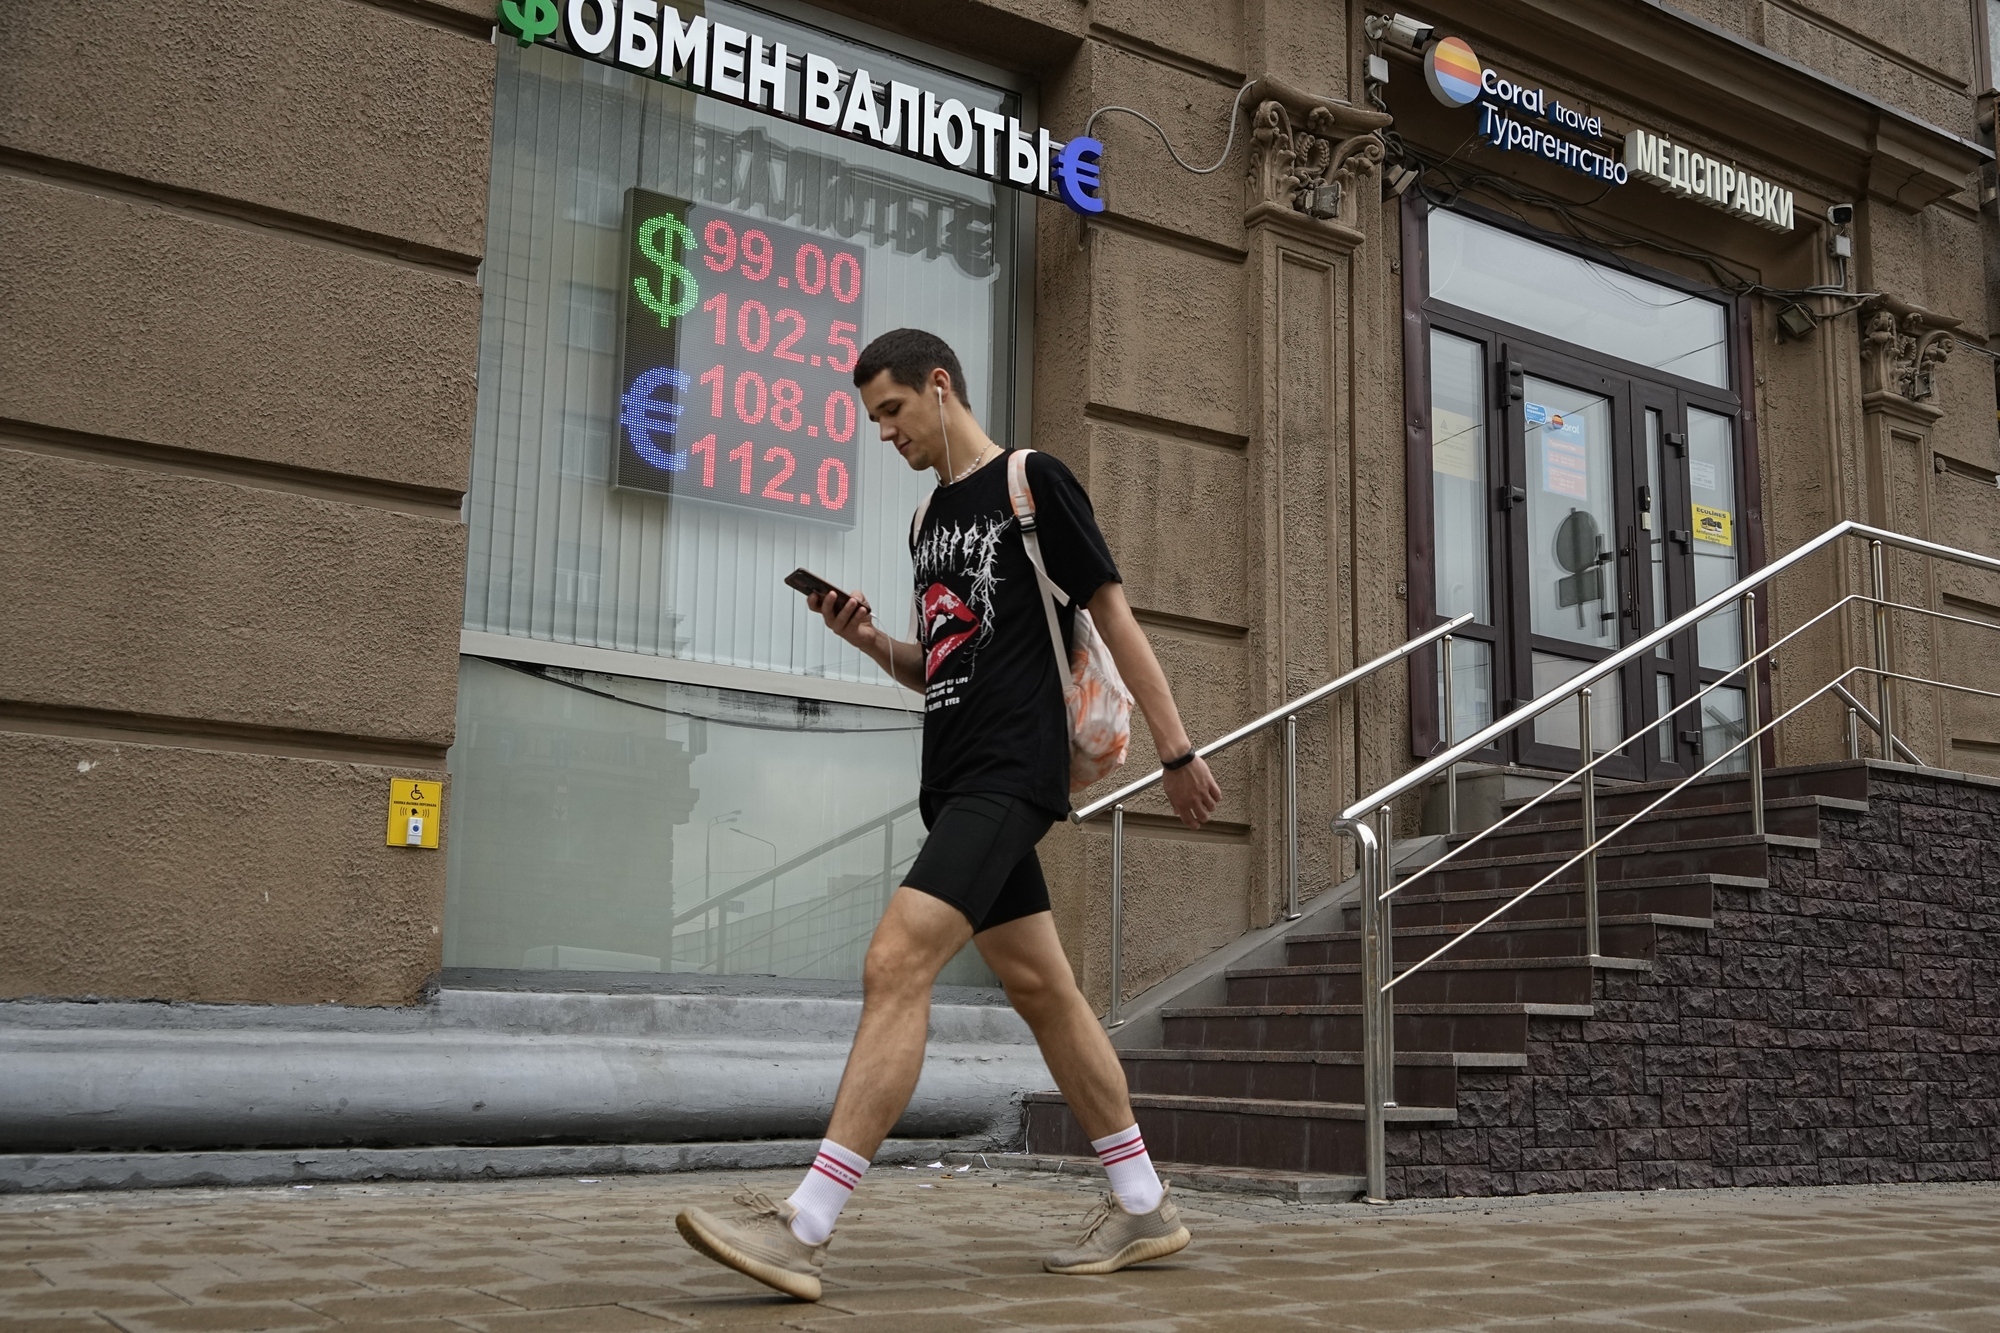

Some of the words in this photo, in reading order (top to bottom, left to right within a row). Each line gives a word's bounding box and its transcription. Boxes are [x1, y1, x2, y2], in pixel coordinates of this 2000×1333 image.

[567, 0, 787, 113] ОБМЕН
[804, 52, 1050, 192] ВАЛЮТЫ
[1556, 100, 1603, 137] travel
[1482, 101, 1628, 185] Турагентство
[1636, 129, 1795, 230] МЕДСПРАВКИ
[703, 219, 861, 304] 99.00
[703, 292, 858, 373] 102.5
[700, 364, 856, 443] 108.0
[1560, 423, 1580, 434] oral
[691, 433, 849, 510] 112.0
